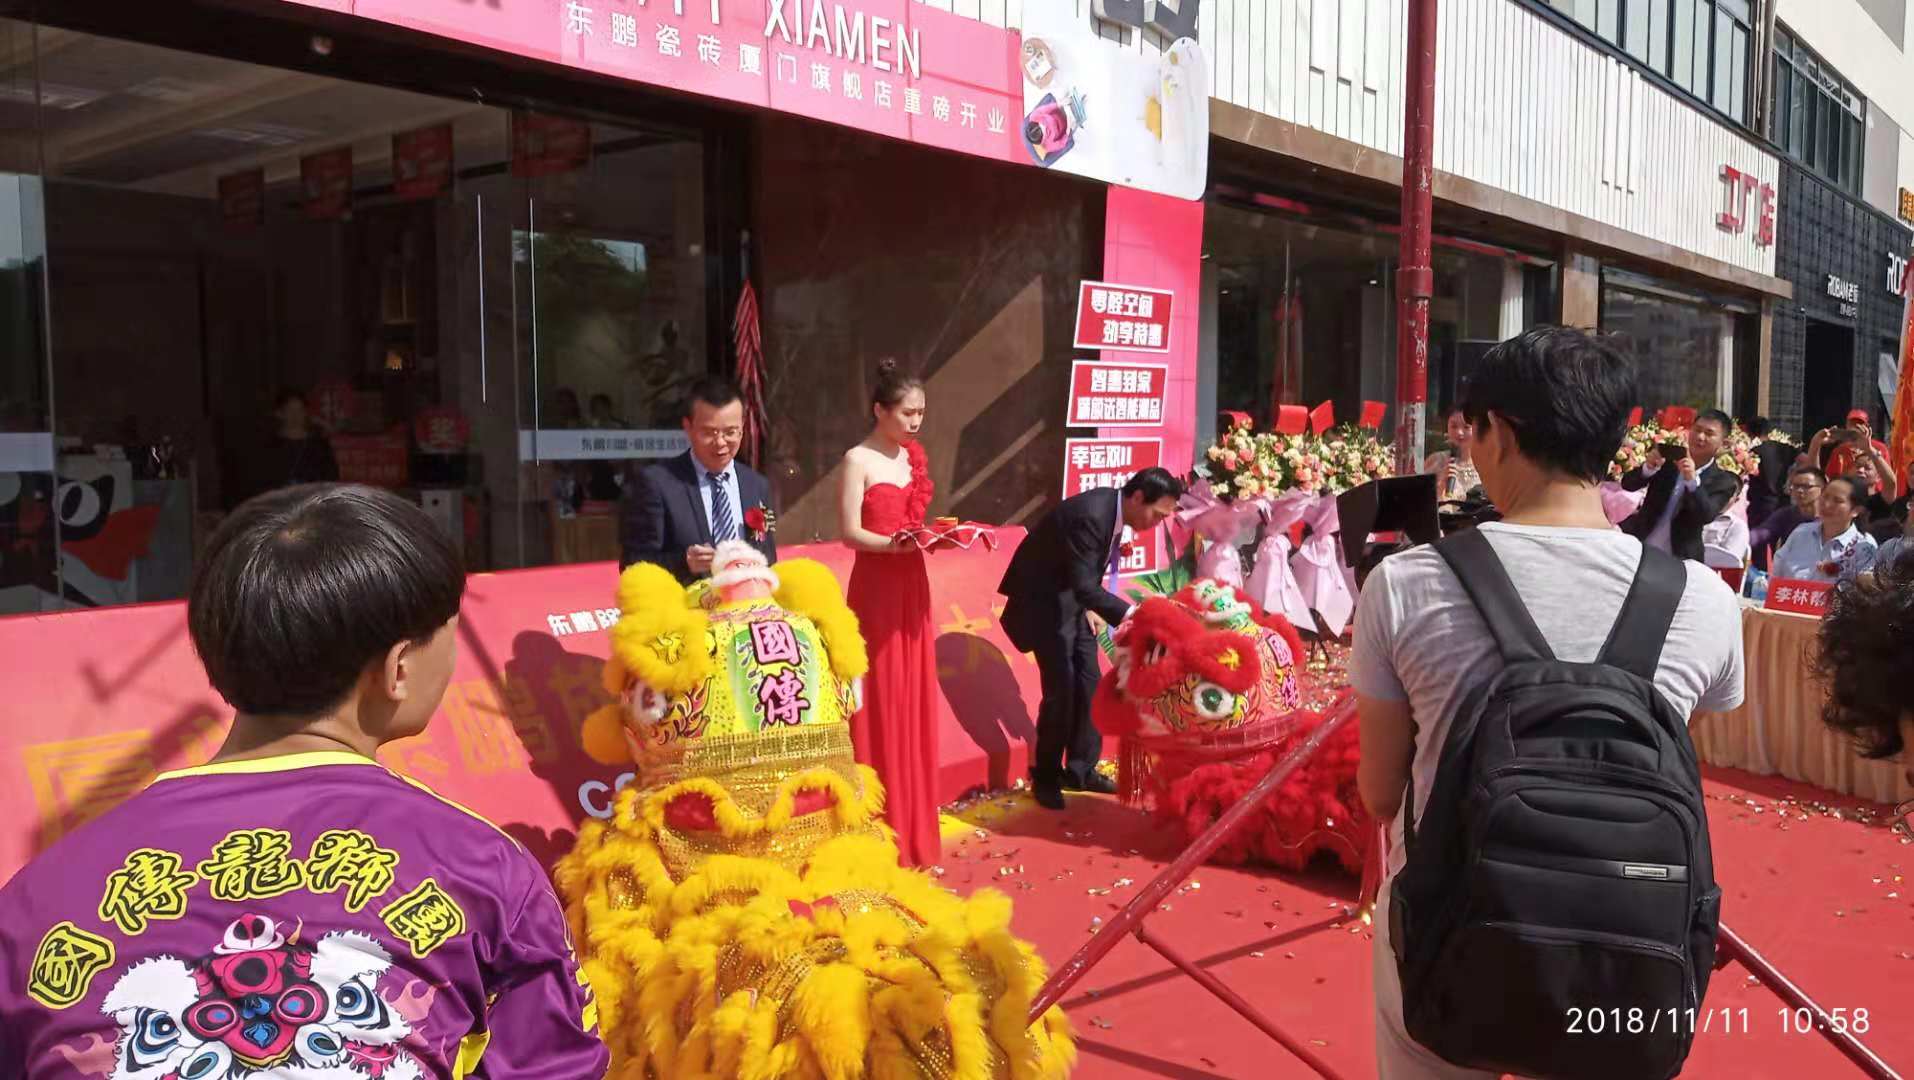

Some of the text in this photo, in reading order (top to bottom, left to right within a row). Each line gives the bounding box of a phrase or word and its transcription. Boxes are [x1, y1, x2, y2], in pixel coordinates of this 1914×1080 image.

[565, 1, 1005, 134] 东鹏瓷砖厦门旗舰店重磅开业
[763, 0, 922, 79] XIAMEN
[1716, 164, 1776, 248] 工厂店
[1071, 446, 1132, 469] 幸运双11
